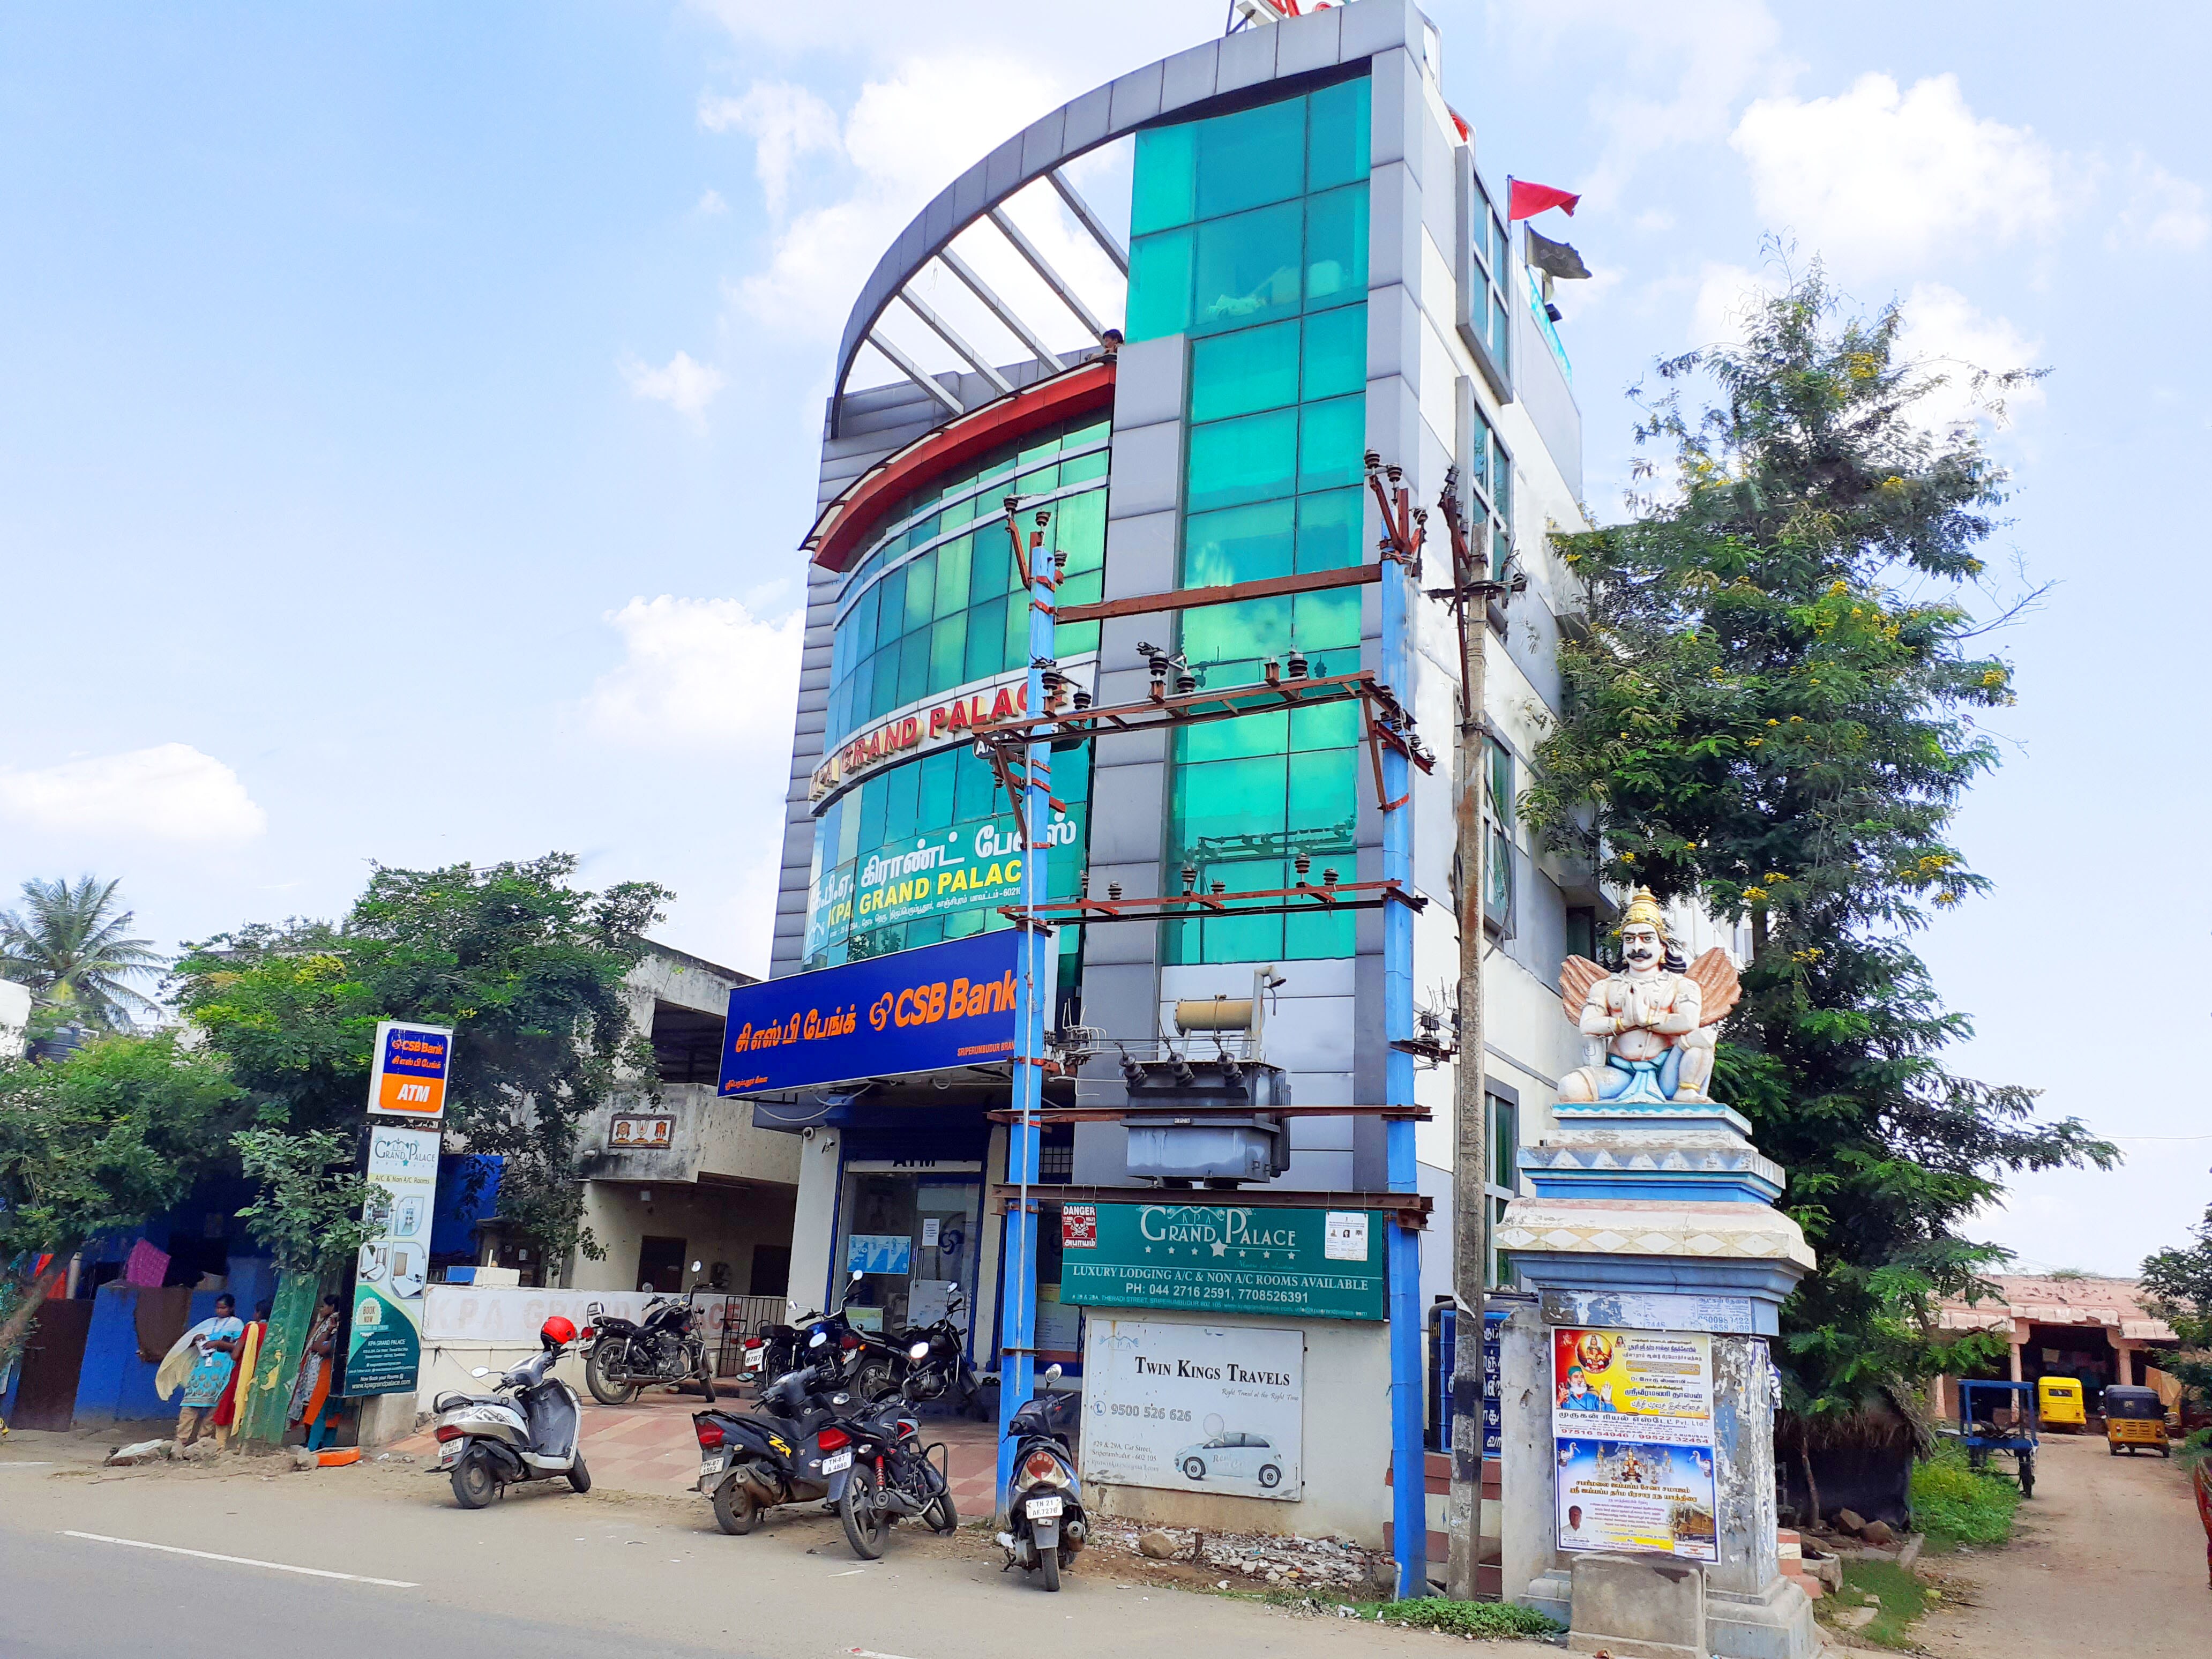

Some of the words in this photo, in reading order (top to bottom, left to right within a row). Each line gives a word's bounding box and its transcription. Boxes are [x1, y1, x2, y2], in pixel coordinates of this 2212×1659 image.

[841, 717, 923, 774] GRAND
[861, 831, 965, 888] கிராண்ட்
[974, 812, 1076, 858] பேஸ்
[827, 900, 853, 928] KPA
[860, 877, 930, 915] GRAND
[937, 860, 1022, 895] PALAC
[894, 982, 947, 1027] CSB
[947, 969, 1018, 1020] Bank
[803, 1004, 857, 1040] பேங்க்
[402, 1040, 421, 1052] CSB
[421, 1042, 444, 1055] Bank
[1000, 1041, 1015, 1051] BRAN
[397, 1083, 430, 1102] ATM
[375, 1140, 406, 1160] GRAND
[408, 1142, 436, 1162] PALACE
[1063, 1206, 1095, 1216] DANGER
[1140, 1206, 1216, 1242] GRAND
[1225, 1208, 1296, 1246] PALACE
[1064, 1238, 1096, 1247] அபாயம்
[1073, 1266, 1117, 1277] LUXURY
[1119, 1268, 1172, 1280] LODGING
[1174, 1271, 1192, 1281] A/C
[1195, 1272, 1204, 1282] &
[1207, 1272, 1232, 1283] NON
[1235, 1273, 1253, 1285] A/C
[1256, 1274, 1298, 1287] ROOMS
[1301, 1276, 1369, 1290] AVAILABLE
[1126, 1282, 1146, 1294] PH:
[1149, 1283, 1169, 1296] 044
[1173, 1284, 1200, 1297] 2716
[1204, 1287, 1234, 1301] 2591,
[1238, 1288, 1308, 1303] 7708526391
[363, 1306, 376, 1315] BOOK
[1134, 1356, 1171, 1377] TWIN
[1177, 1359, 1221, 1380] KINGS
[1227, 1363, 1290, 1386] TRAVELS
[1110, 1403, 1140, 1417] 9500
[1143, 1405, 1165, 1419] 526
[1169, 1408, 1192, 1422] 626
